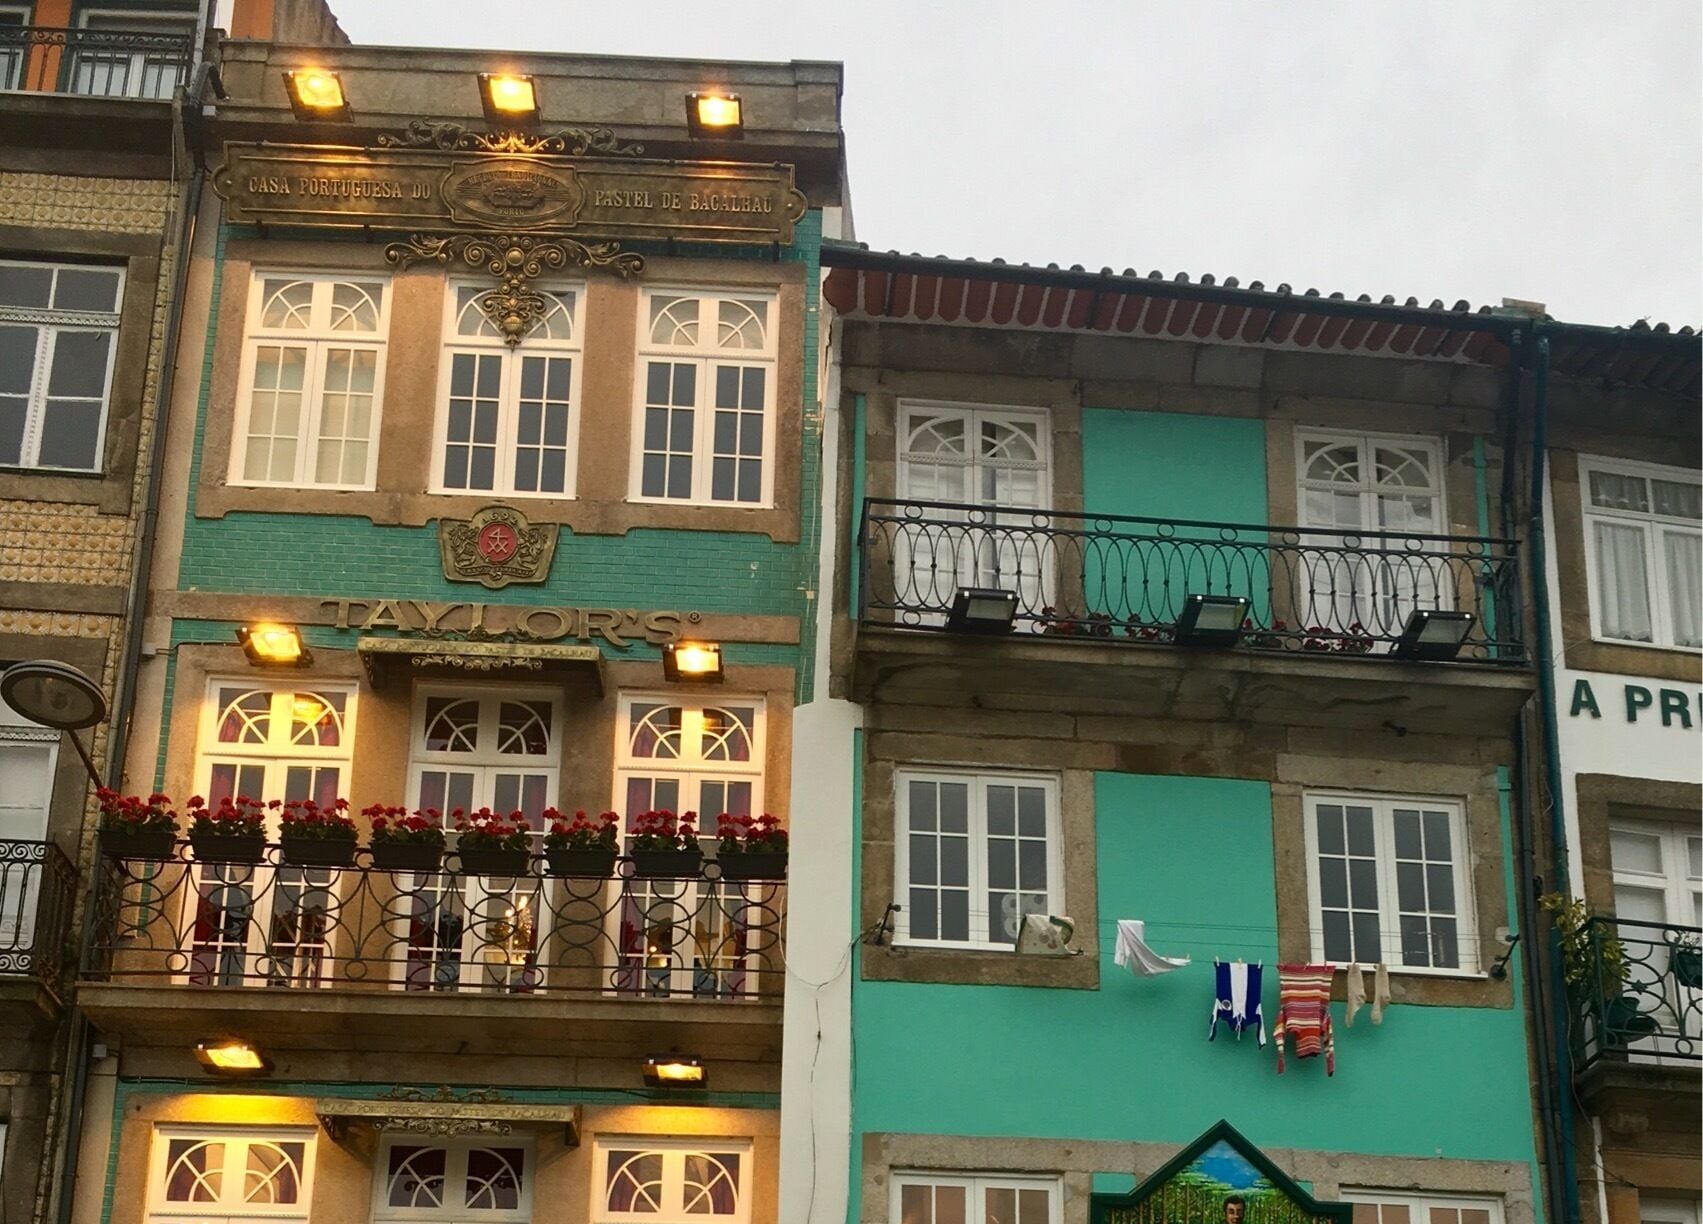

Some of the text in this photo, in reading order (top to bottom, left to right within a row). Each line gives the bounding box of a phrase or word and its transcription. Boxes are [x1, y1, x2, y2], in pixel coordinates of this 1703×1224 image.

[250, 177, 431, 199] CASA PORTUGUESA DO
[595, 190, 772, 213] PASTEL DE BACALHAU
[1570, 679, 1601, 718] A
